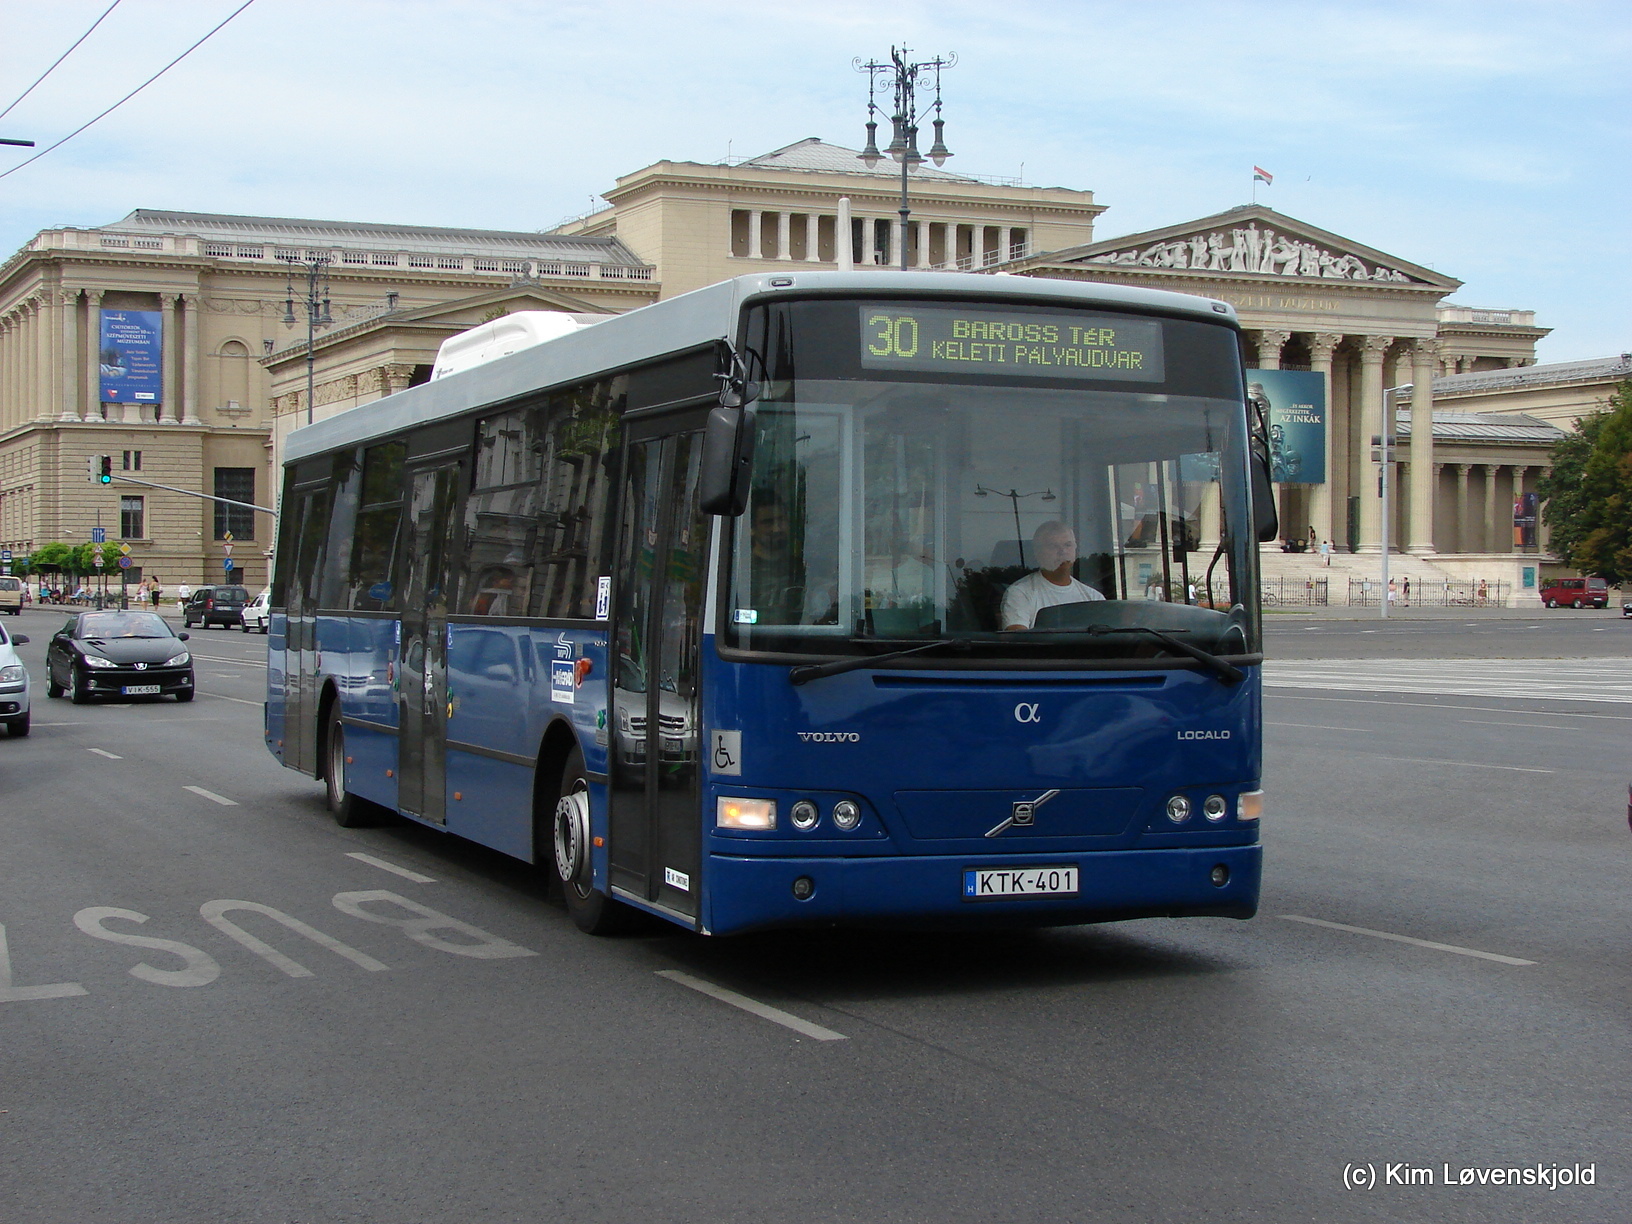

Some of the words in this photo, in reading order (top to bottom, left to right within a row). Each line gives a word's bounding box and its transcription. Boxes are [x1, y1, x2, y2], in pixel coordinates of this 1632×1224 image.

[868, 315, 918, 358] 30
[953, 319, 1059, 344] BAROSS
[1069, 326, 1116, 347] TÉR
[932, 340, 1006, 363] KELETI
[1015, 345, 1143, 370] PÁLYAUDVAR
[1280, 414, 1292, 423] AZ
[1293, 413, 1321, 424] INKÁK
[797, 732, 860, 743] VOLVO
[1177, 730, 1231, 740] LOCALO
[967, 885, 974, 893] H
[981, 870, 1071, 893] KTK-401
